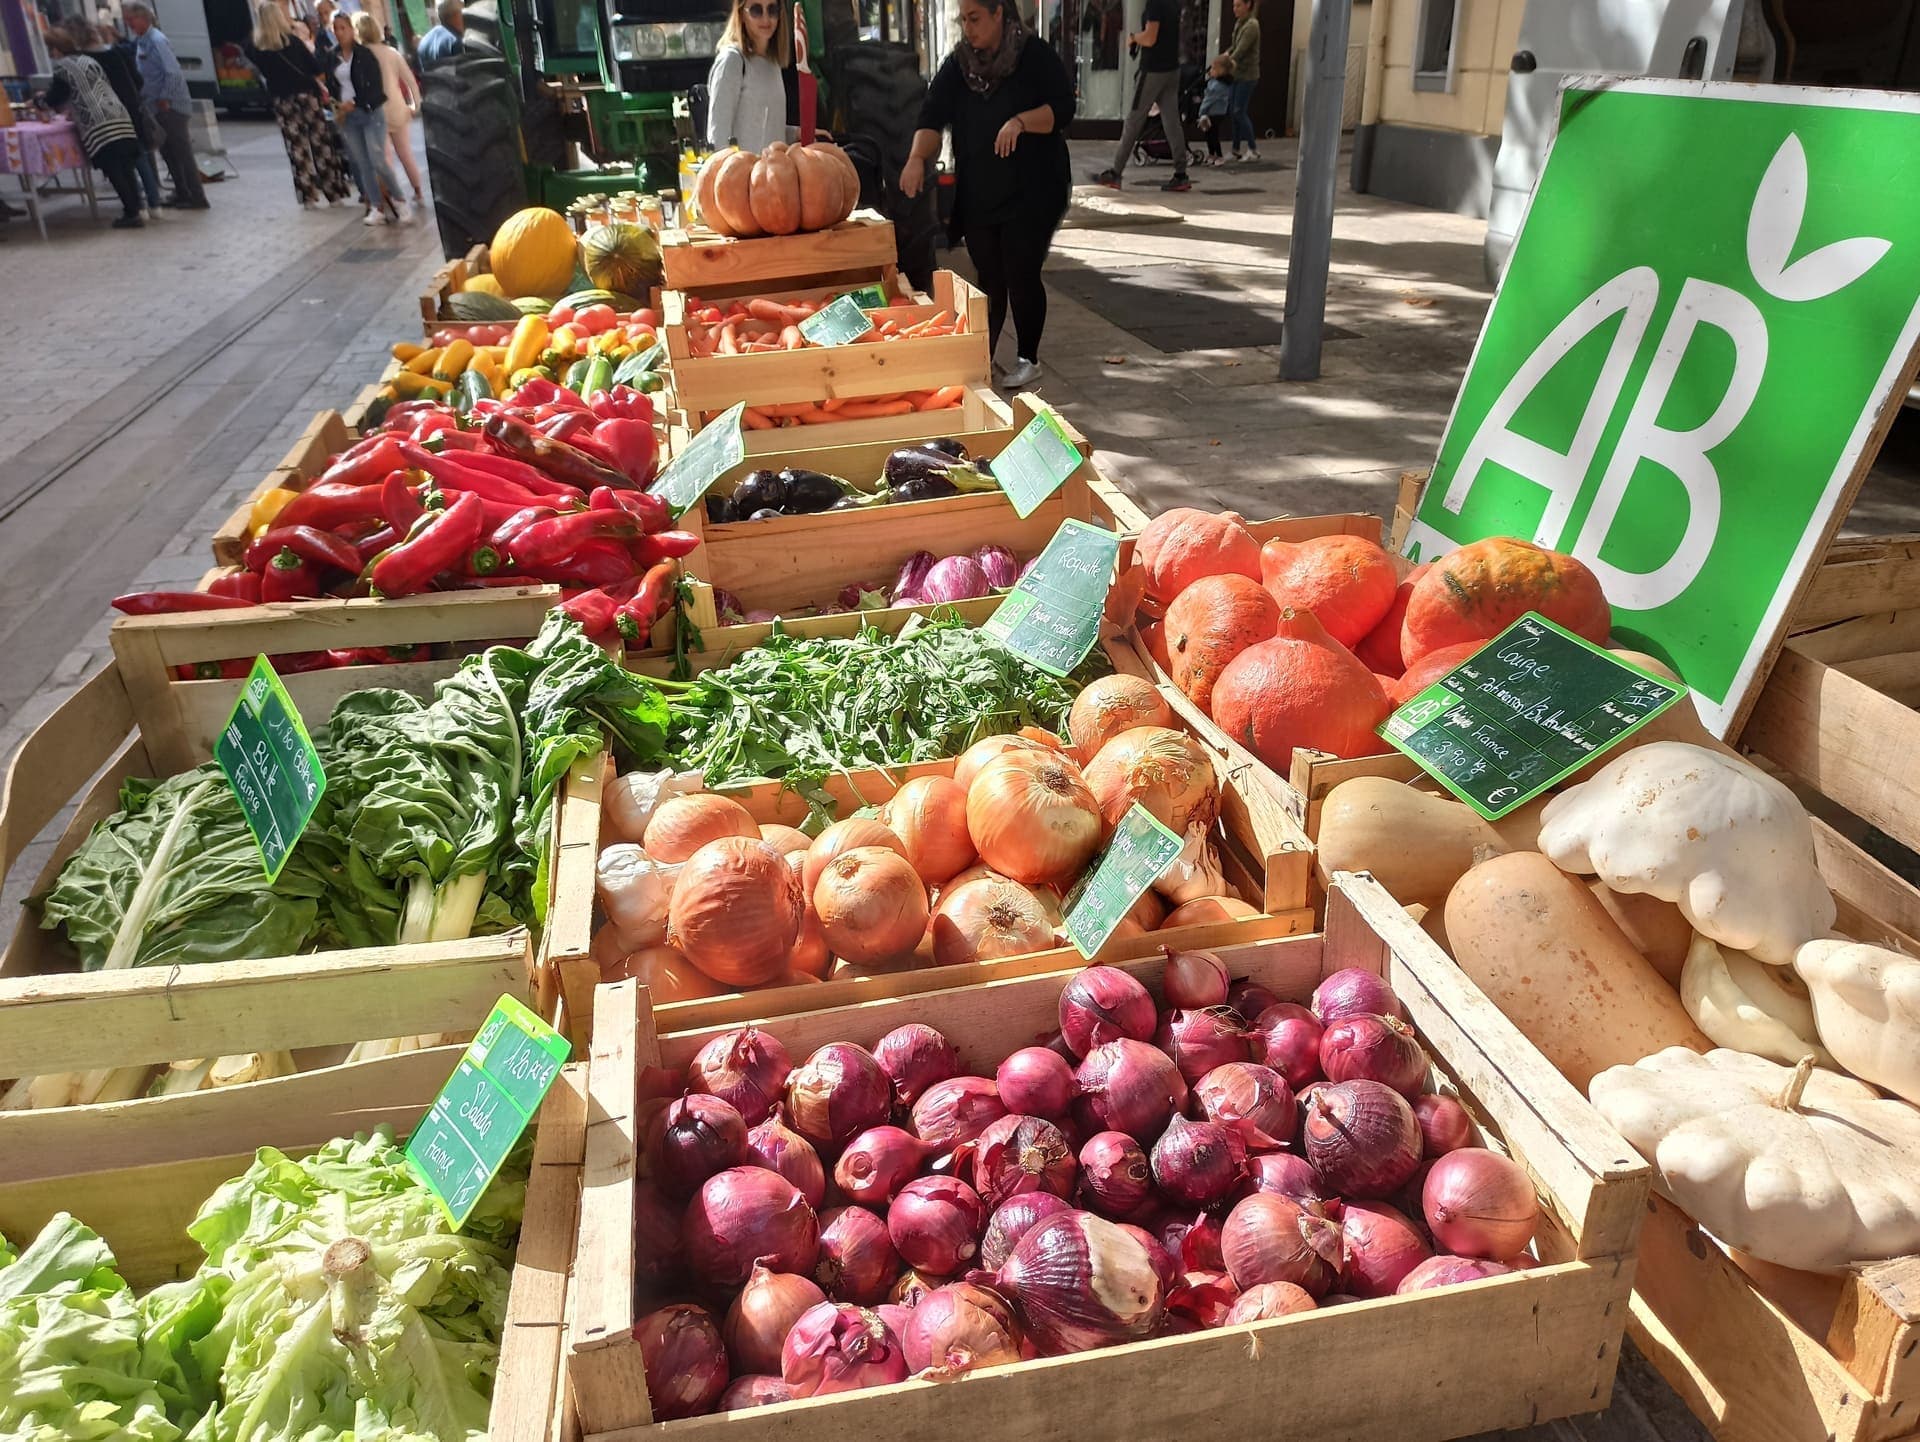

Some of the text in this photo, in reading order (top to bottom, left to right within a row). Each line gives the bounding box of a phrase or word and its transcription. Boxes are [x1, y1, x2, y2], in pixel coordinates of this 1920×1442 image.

[1443, 265, 1769, 611] AB
[1058, 546, 1101, 578] Roquette
[1496, 637, 1550, 682] Courge
[250, 677, 267, 699] AB
[1400, 698, 1441, 724] AB
[1471, 724, 1509, 760] France
[1487, 786, 1518, 804] €
[459, 1081, 499, 1140] Salade
